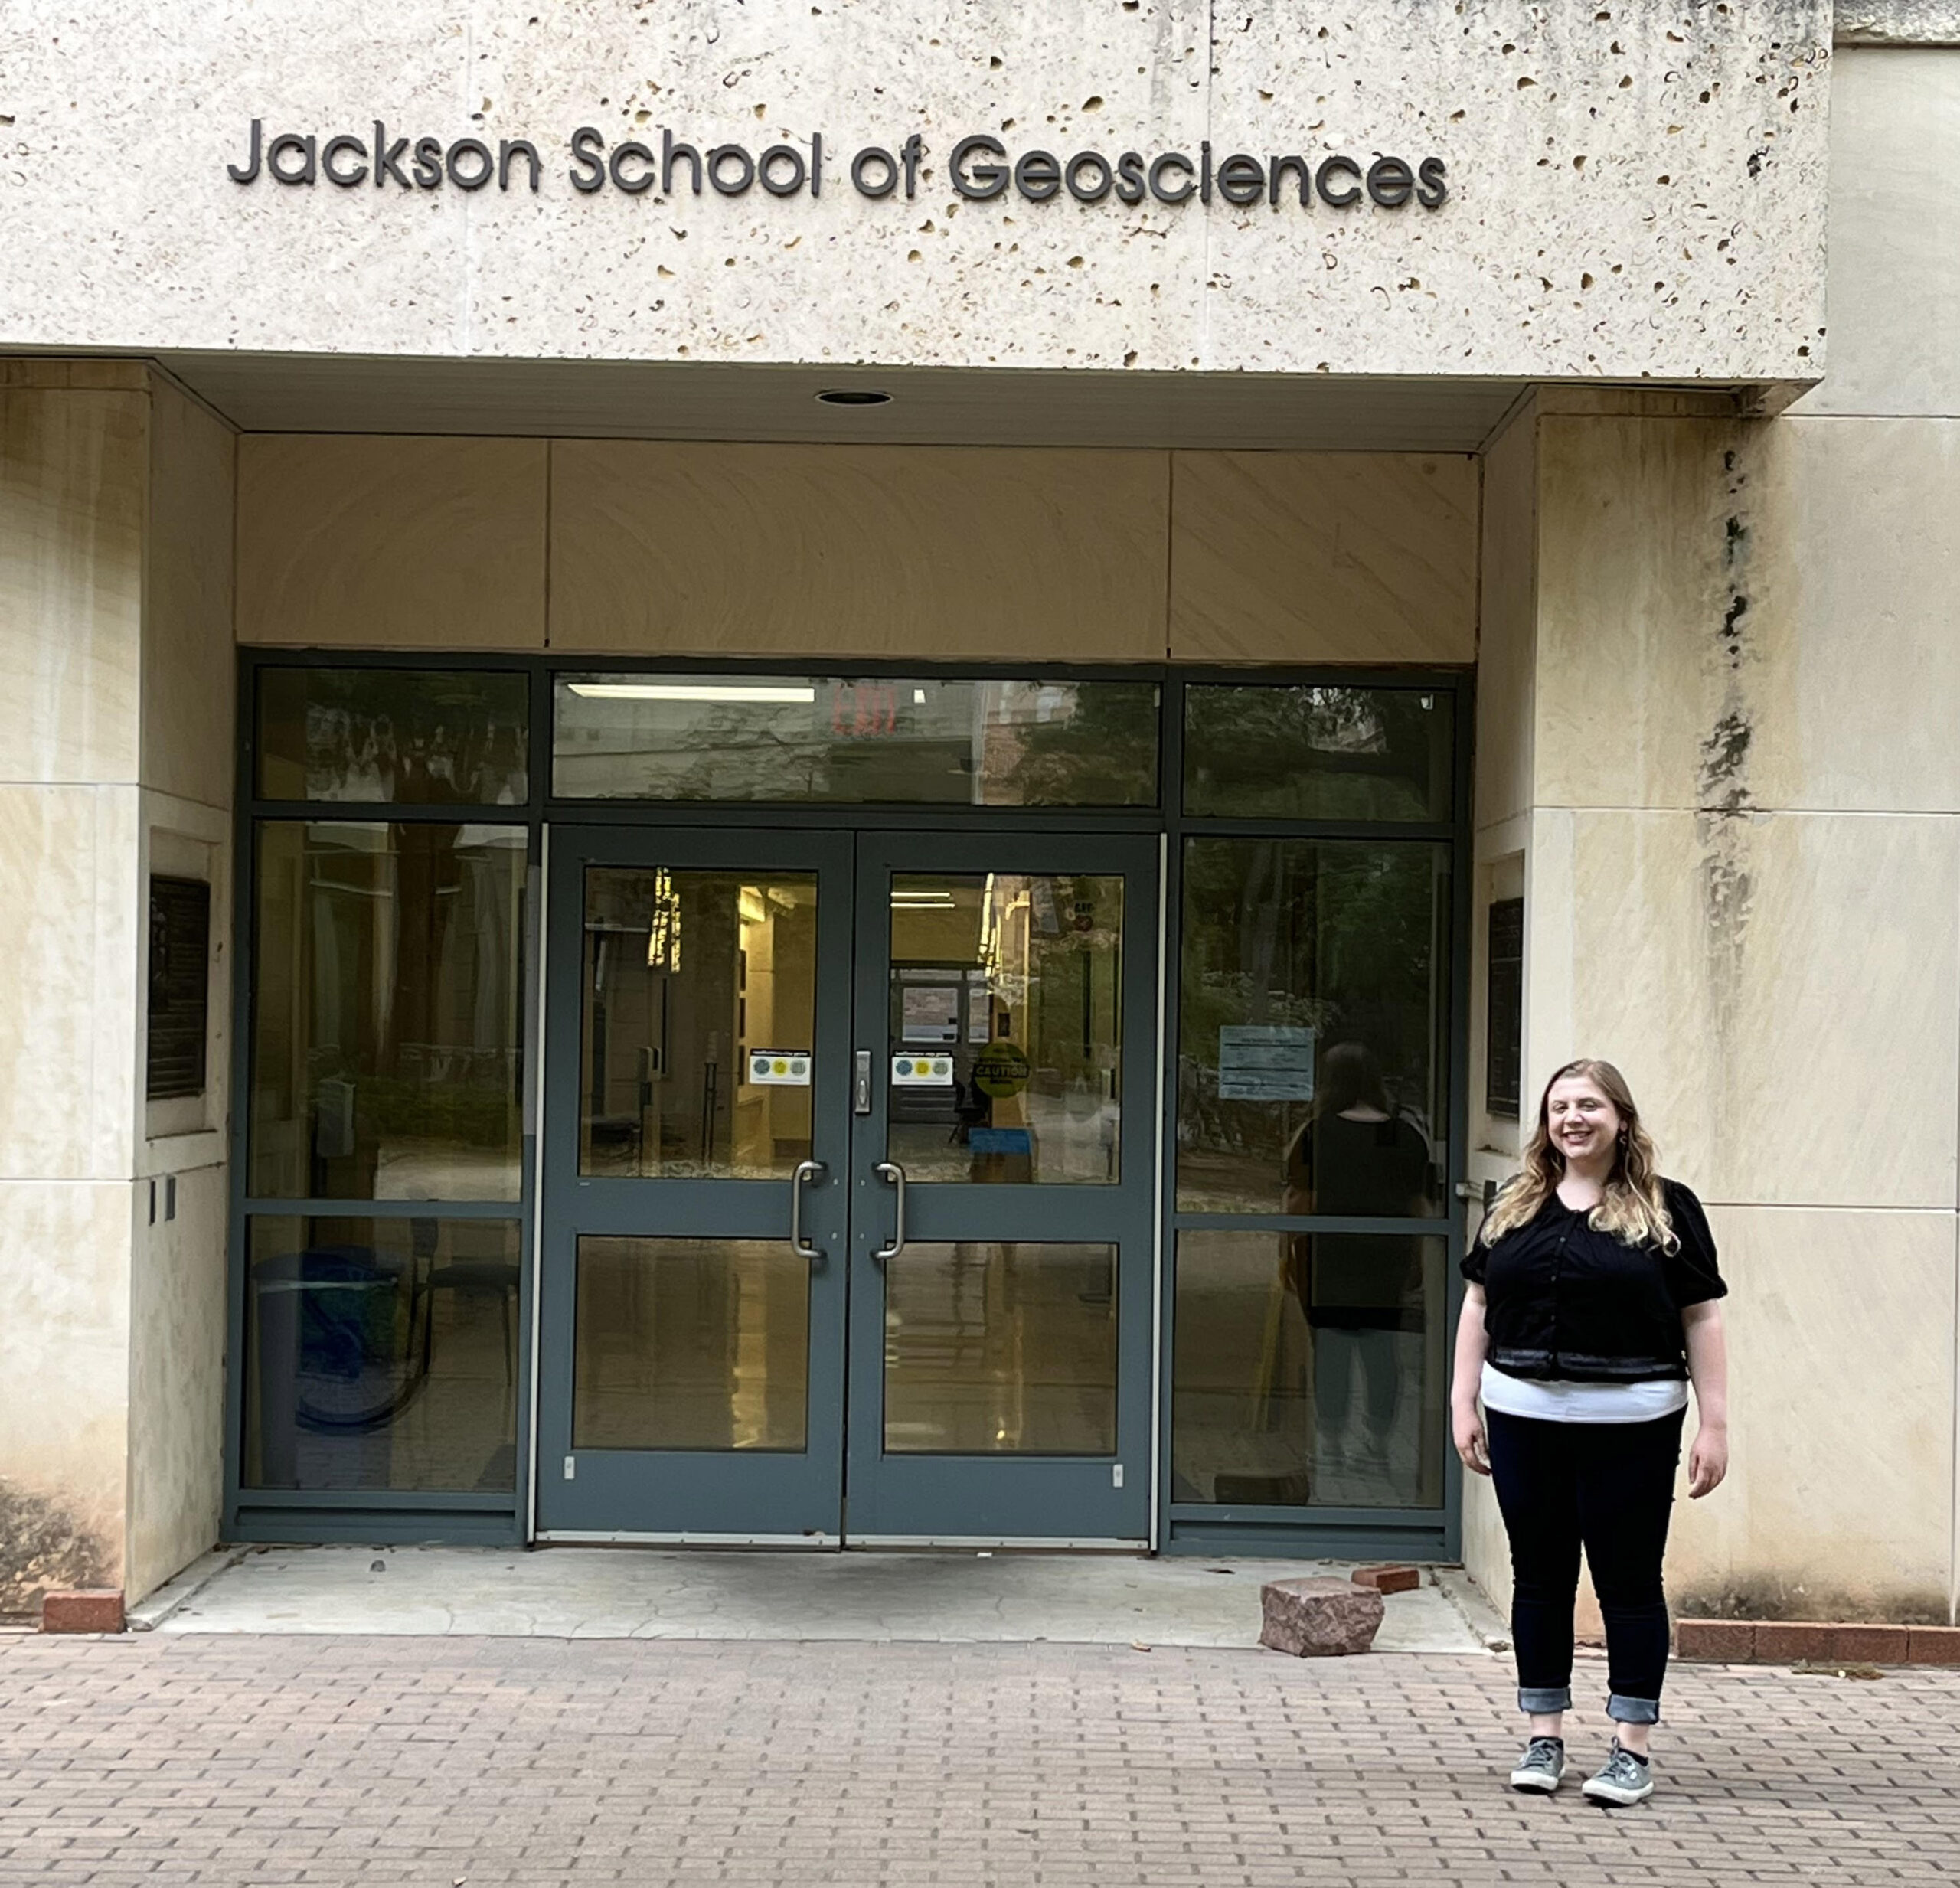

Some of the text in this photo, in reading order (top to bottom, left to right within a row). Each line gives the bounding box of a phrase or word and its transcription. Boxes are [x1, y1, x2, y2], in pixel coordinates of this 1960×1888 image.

[227, 119, 1449, 213] Jackson School of Geosciences
[975, 1066, 1028, 1077] CAUTION
